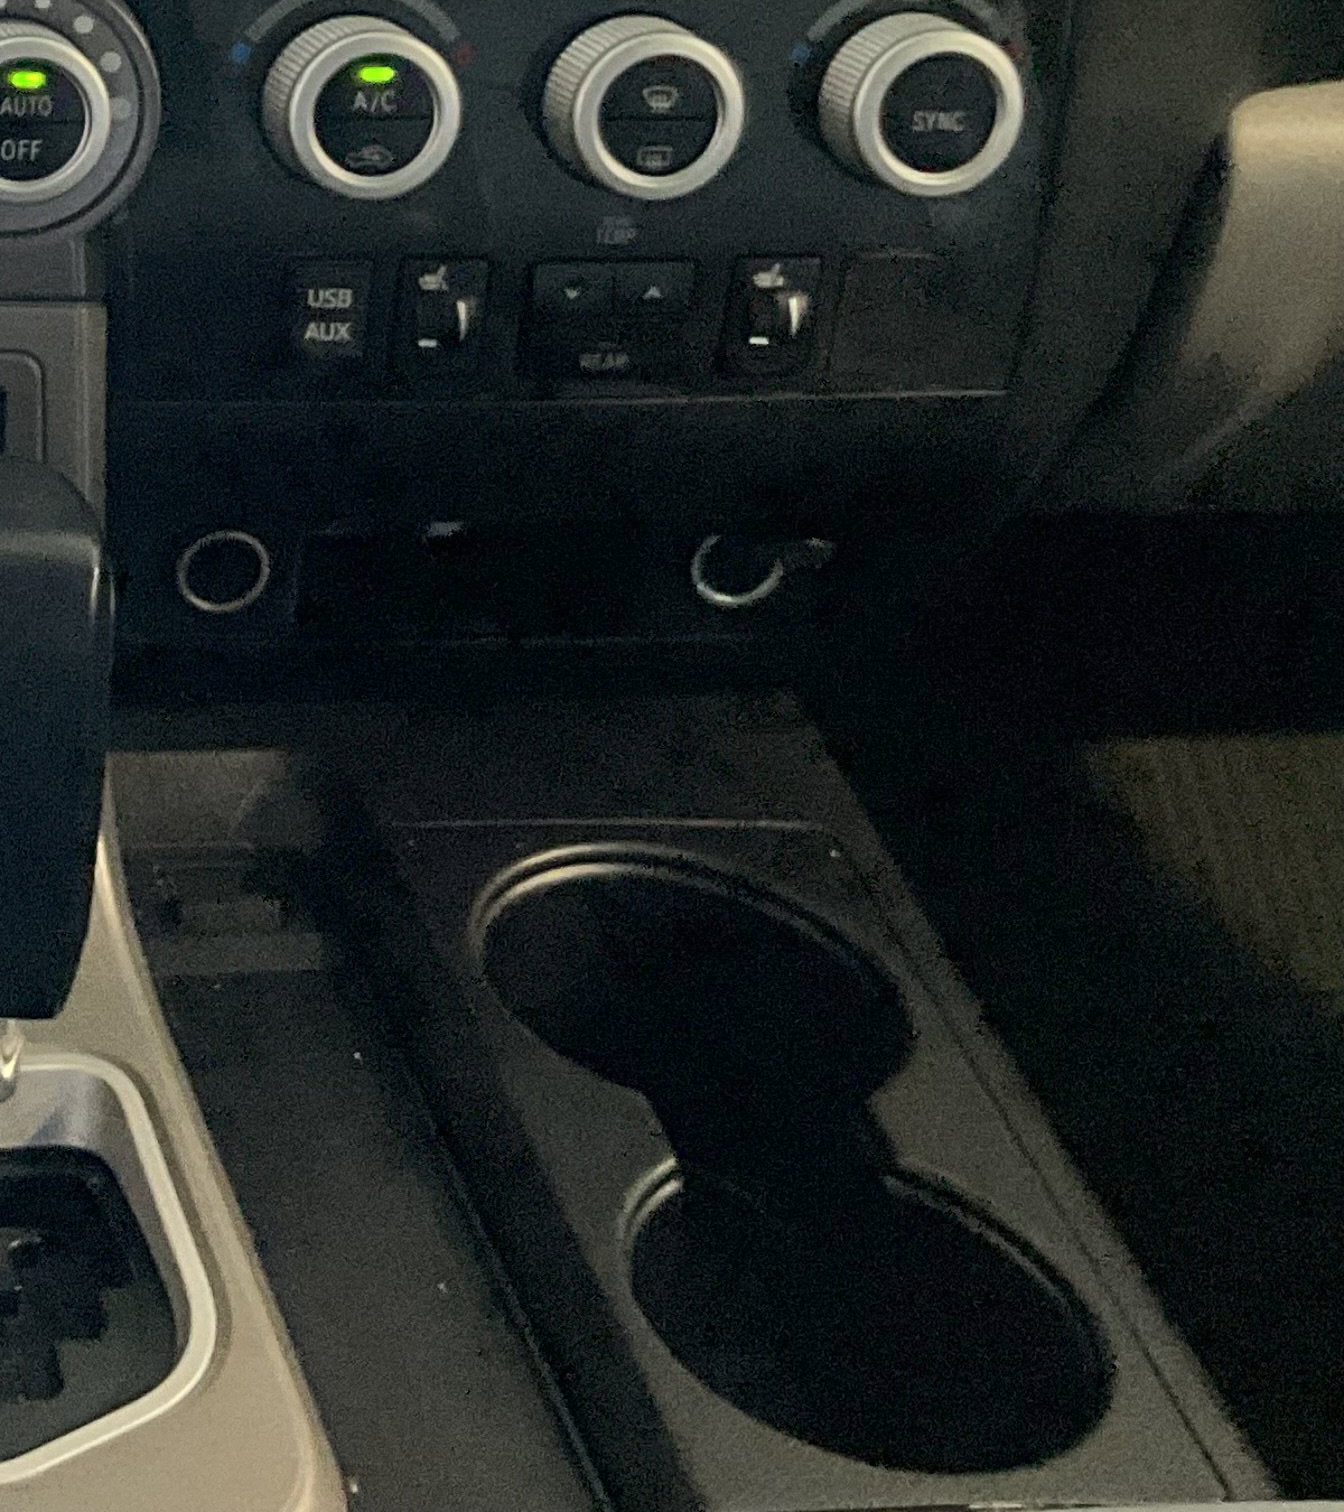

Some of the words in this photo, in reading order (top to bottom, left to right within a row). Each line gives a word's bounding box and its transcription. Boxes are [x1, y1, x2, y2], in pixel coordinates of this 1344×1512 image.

[0, 95, 52, 117] AUTO
[353, 89, 398, 113] A/C
[913, 110, 965, 133] SYNC
[1, 139, 42, 161] OFF
[307, 288, 352, 308] USB
[304, 322, 352, 342] AUX
